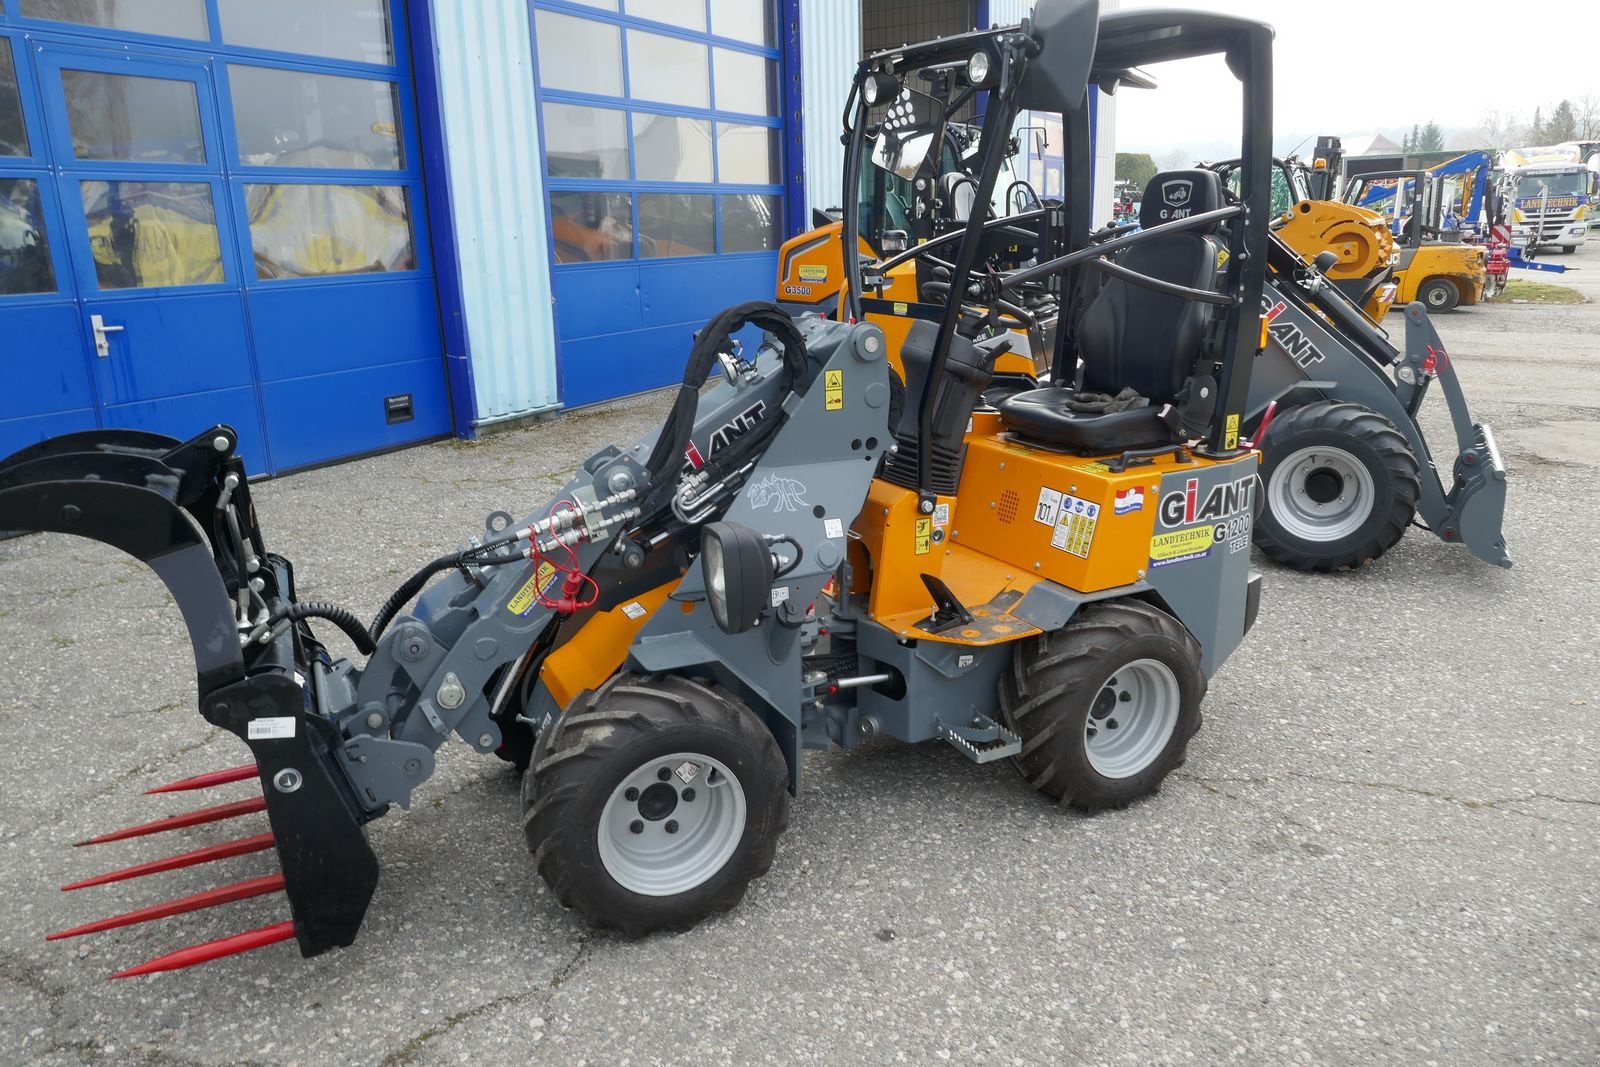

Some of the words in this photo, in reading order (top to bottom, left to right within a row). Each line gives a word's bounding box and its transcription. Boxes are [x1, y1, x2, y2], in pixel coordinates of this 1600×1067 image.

[785, 285, 811, 295] G3500
[1037, 502, 1051, 522] 101
[1152, 528, 1211, 548] LANDTECHNIK
[1212, 512, 1251, 544] G1200
[1229, 534, 1249, 554] TELE
[1152, 552, 1207, 567] www.landtechnik.co.at
